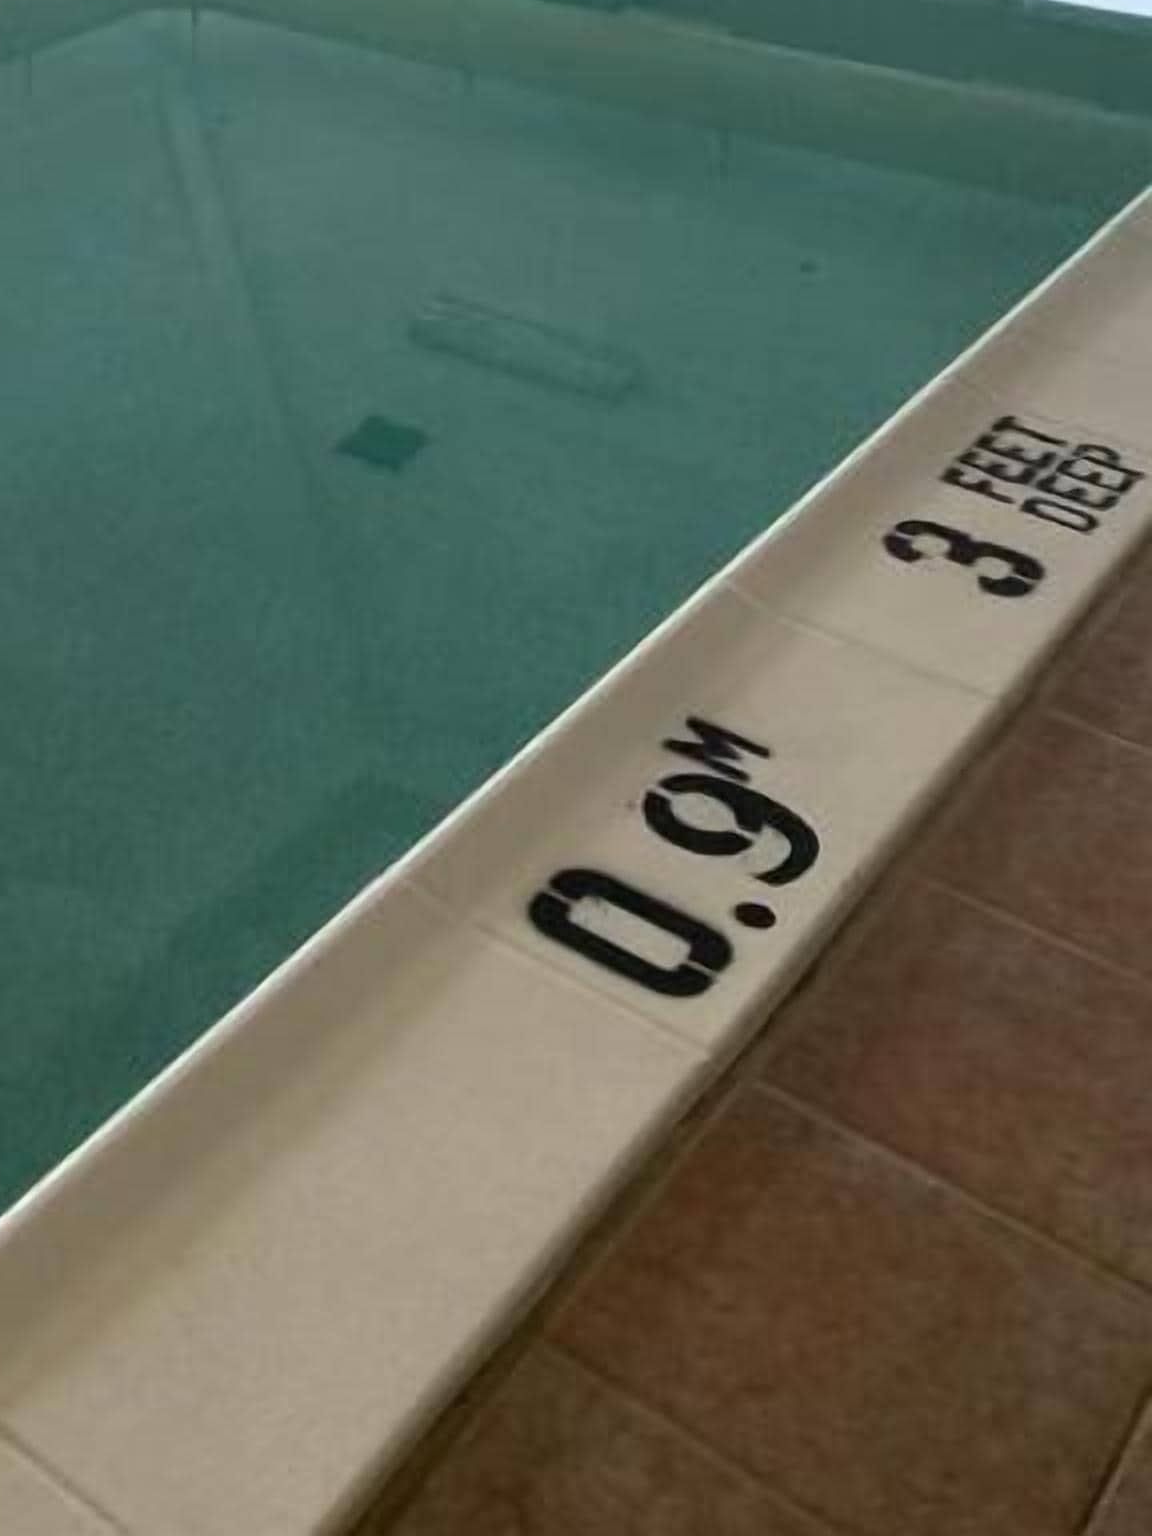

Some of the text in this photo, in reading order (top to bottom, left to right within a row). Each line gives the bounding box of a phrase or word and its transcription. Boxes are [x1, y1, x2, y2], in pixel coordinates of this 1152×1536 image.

[882, 415, 1068, 597] 3 FEET
[1020, 444, 1145, 534] DEEP
